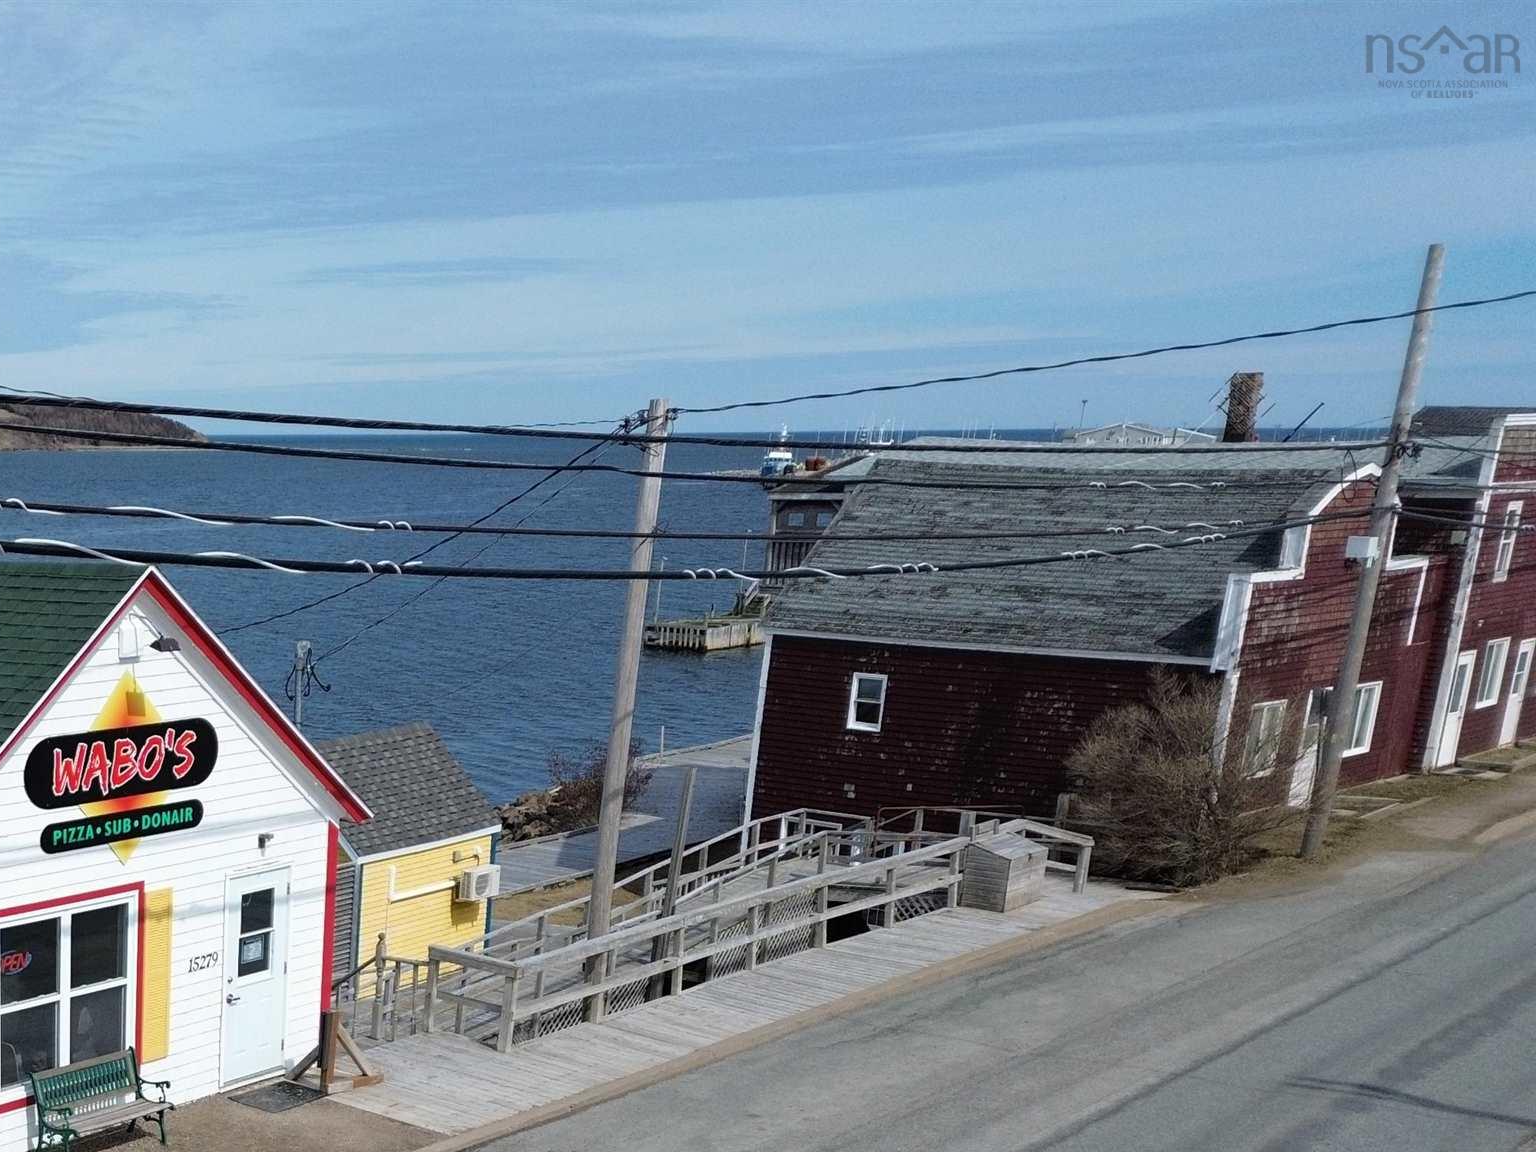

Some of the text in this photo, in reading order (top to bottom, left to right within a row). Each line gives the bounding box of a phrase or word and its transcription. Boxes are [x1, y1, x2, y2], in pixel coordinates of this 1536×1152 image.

[51, 728, 198, 797] WABO'S
[52, 806, 194, 846] PIZZA SUB DONAIR
[187, 951, 219, 974] 15279
